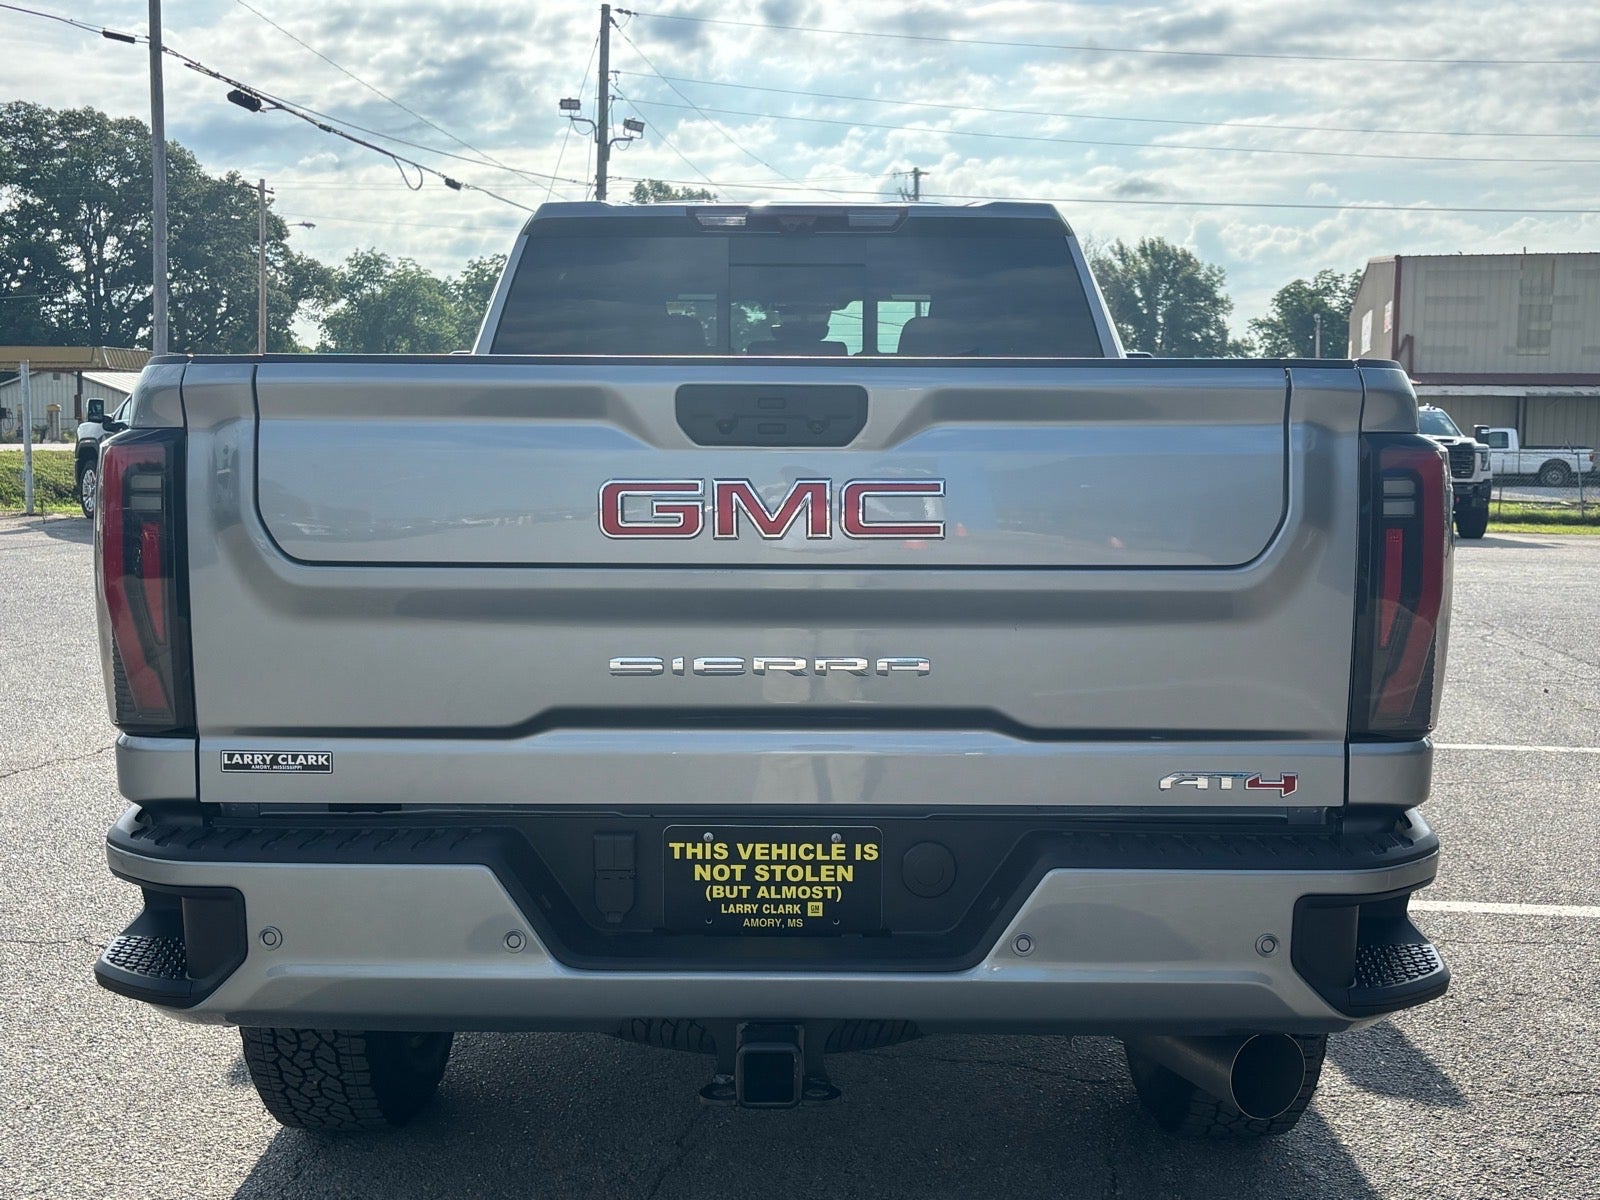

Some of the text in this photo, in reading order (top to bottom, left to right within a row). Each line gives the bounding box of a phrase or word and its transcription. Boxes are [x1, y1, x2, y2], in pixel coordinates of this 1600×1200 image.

[598, 478, 946, 540] GMC
[608, 656, 930, 676] SIERRA
[223, 753, 328, 765] LARRY CLARK
[1159, 771, 1298, 798] AT4
[669, 842, 879, 861] THIS VEHICLE IS
[694, 864, 854, 882] NOT STOLEN
[705, 885, 842, 902] (BUT ALMOST)
[721, 903, 801, 914] LARRY CLARK
[743, 918, 803, 928] AMORY, MS
